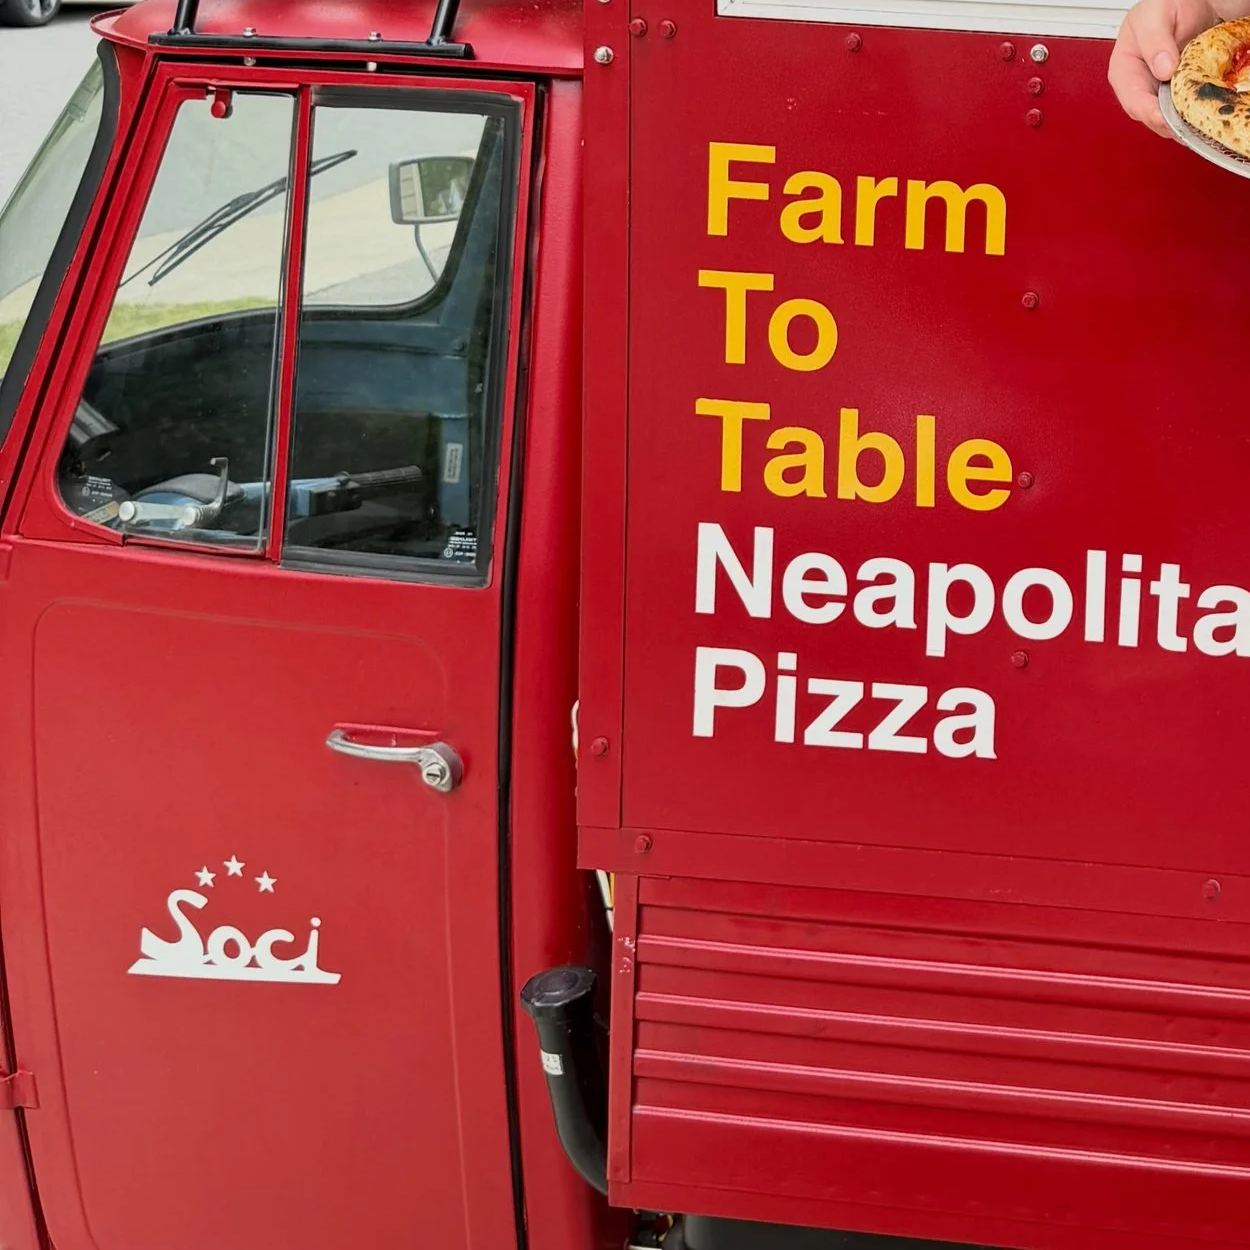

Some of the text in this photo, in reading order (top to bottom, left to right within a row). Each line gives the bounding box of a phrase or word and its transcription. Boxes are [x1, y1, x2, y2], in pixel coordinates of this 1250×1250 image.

[707, 142, 1007, 256] Farm
[698, 269, 838, 372] To
[696, 398, 1013, 511] Table
[692, 646, 998, 760] Pizza
[127, 888, 342, 985] Soci
